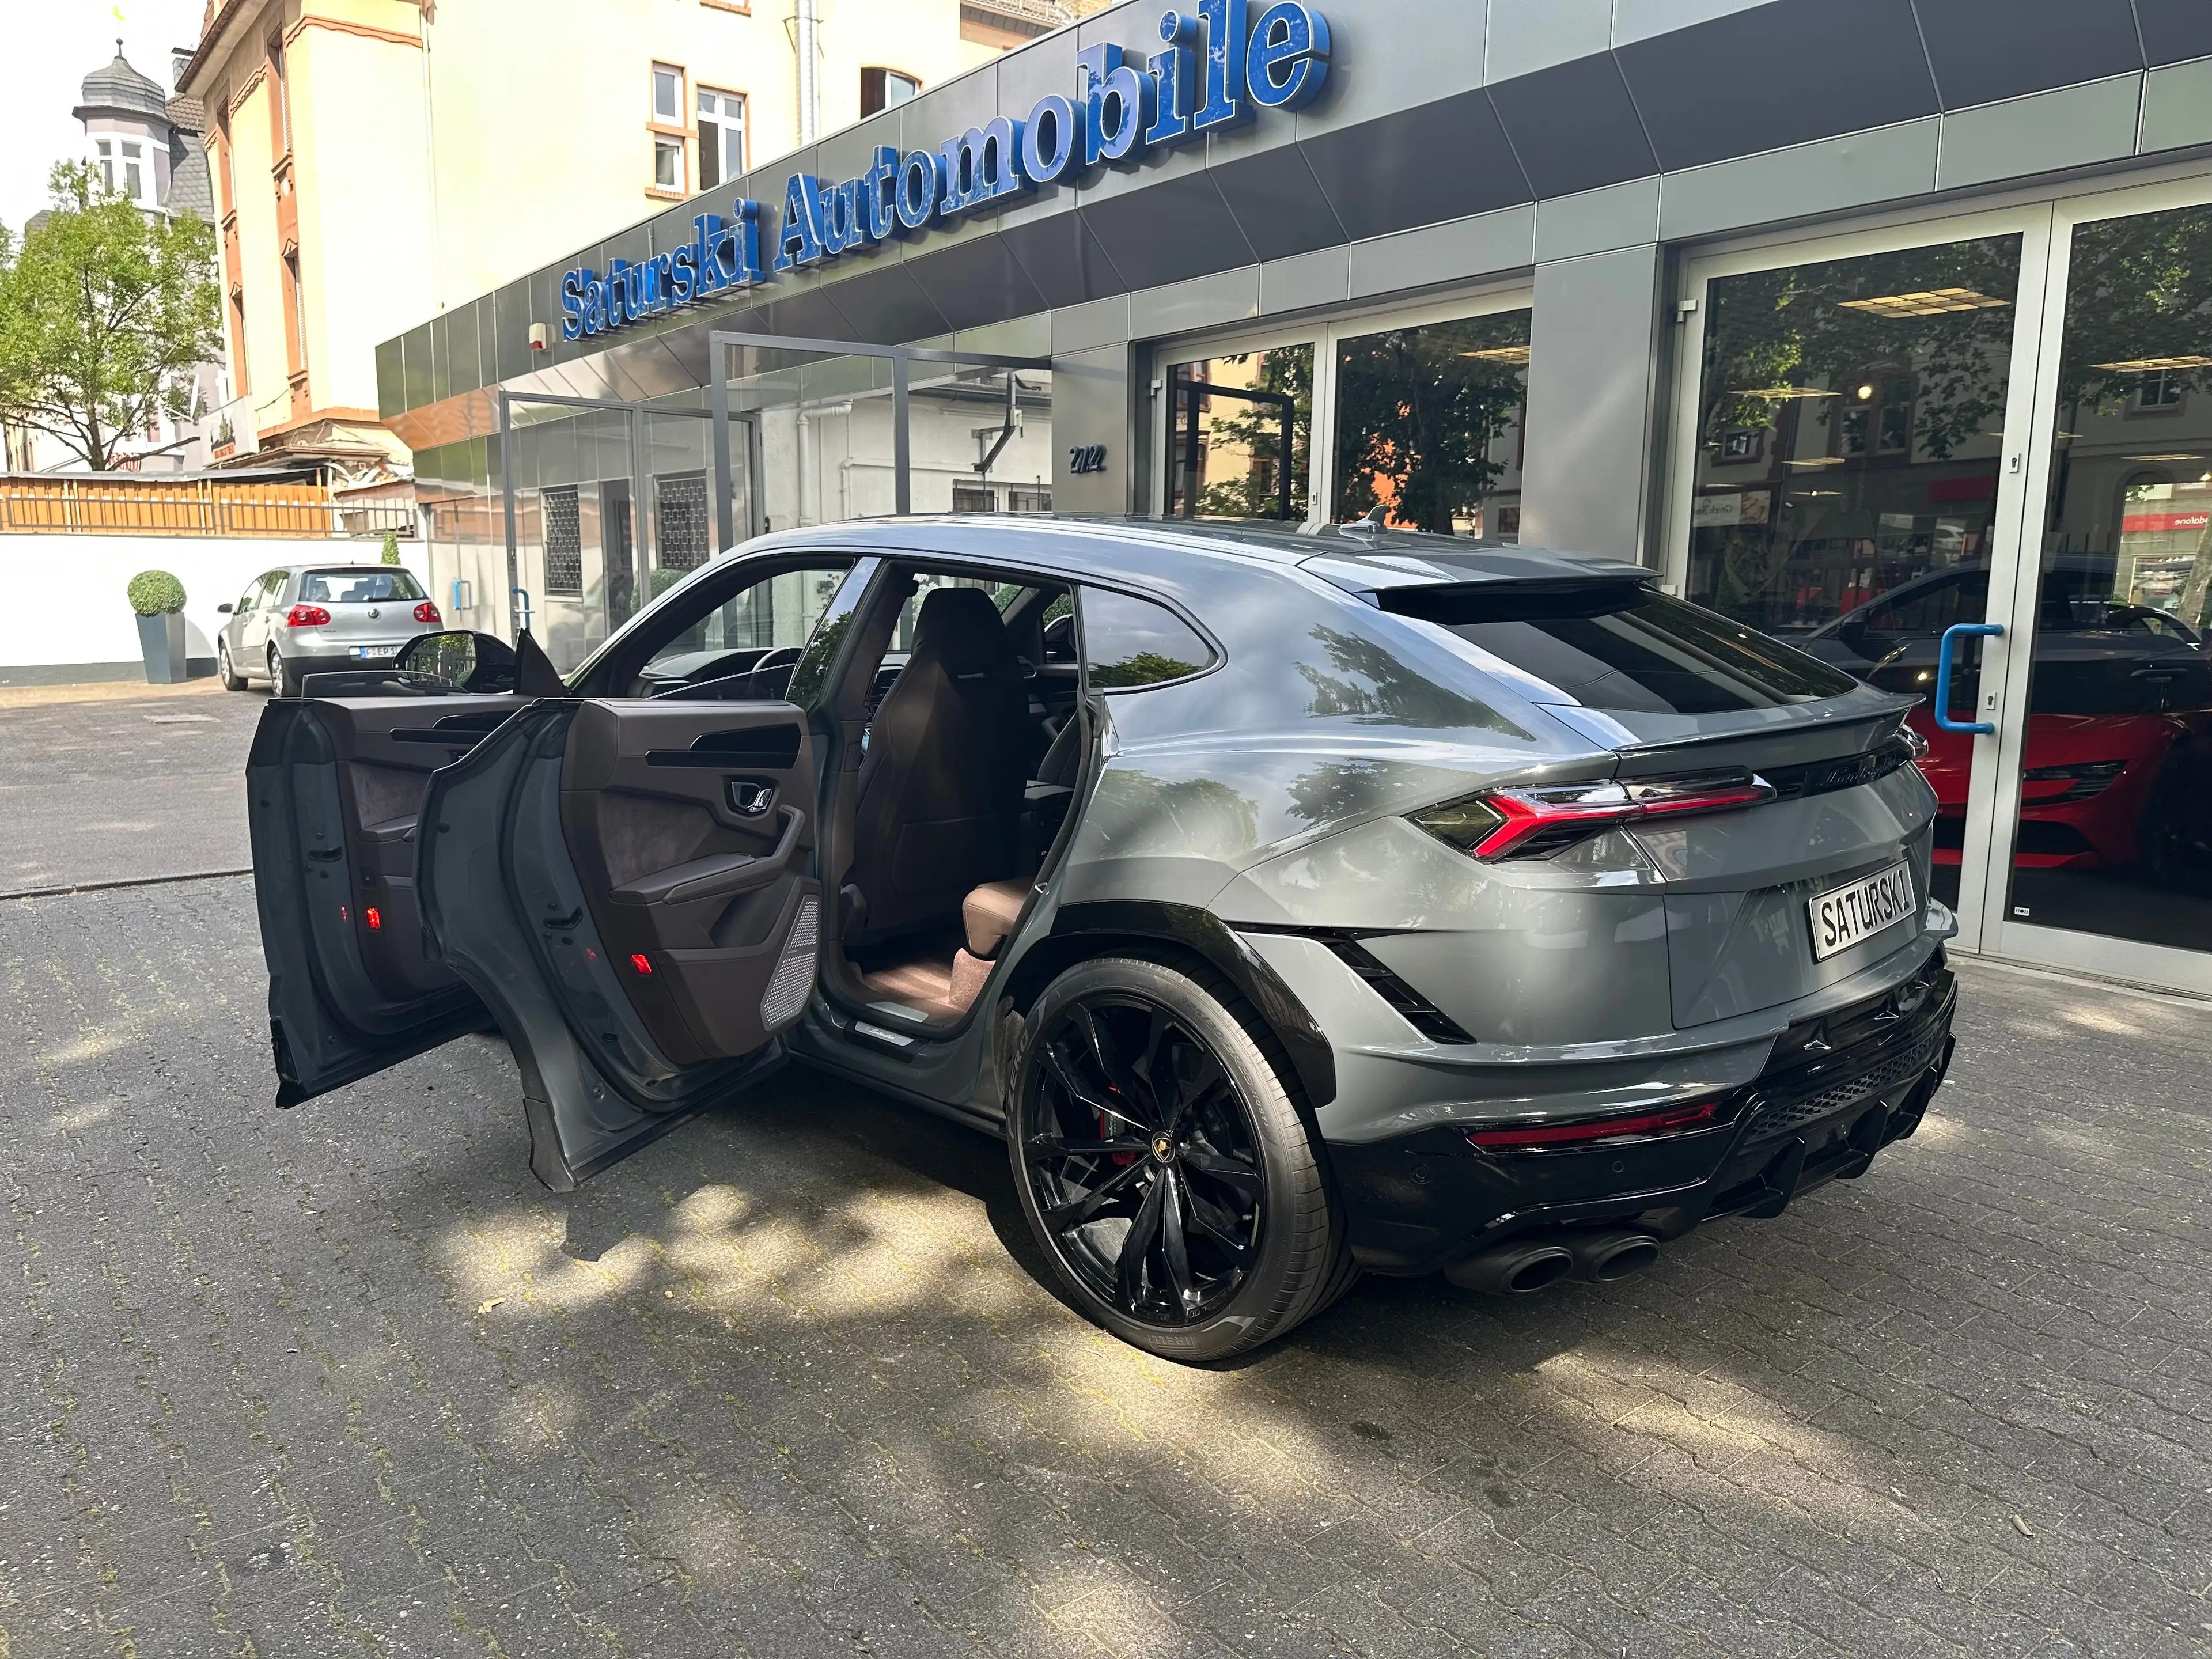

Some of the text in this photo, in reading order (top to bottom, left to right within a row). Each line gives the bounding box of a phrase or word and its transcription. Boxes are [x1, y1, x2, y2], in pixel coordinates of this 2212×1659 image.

[562, 0, 1330, 341] Saturski Automobile
[1821, 870, 1910, 947] SATURSKI
[1007, 1028, 1029, 1112] ZERO
